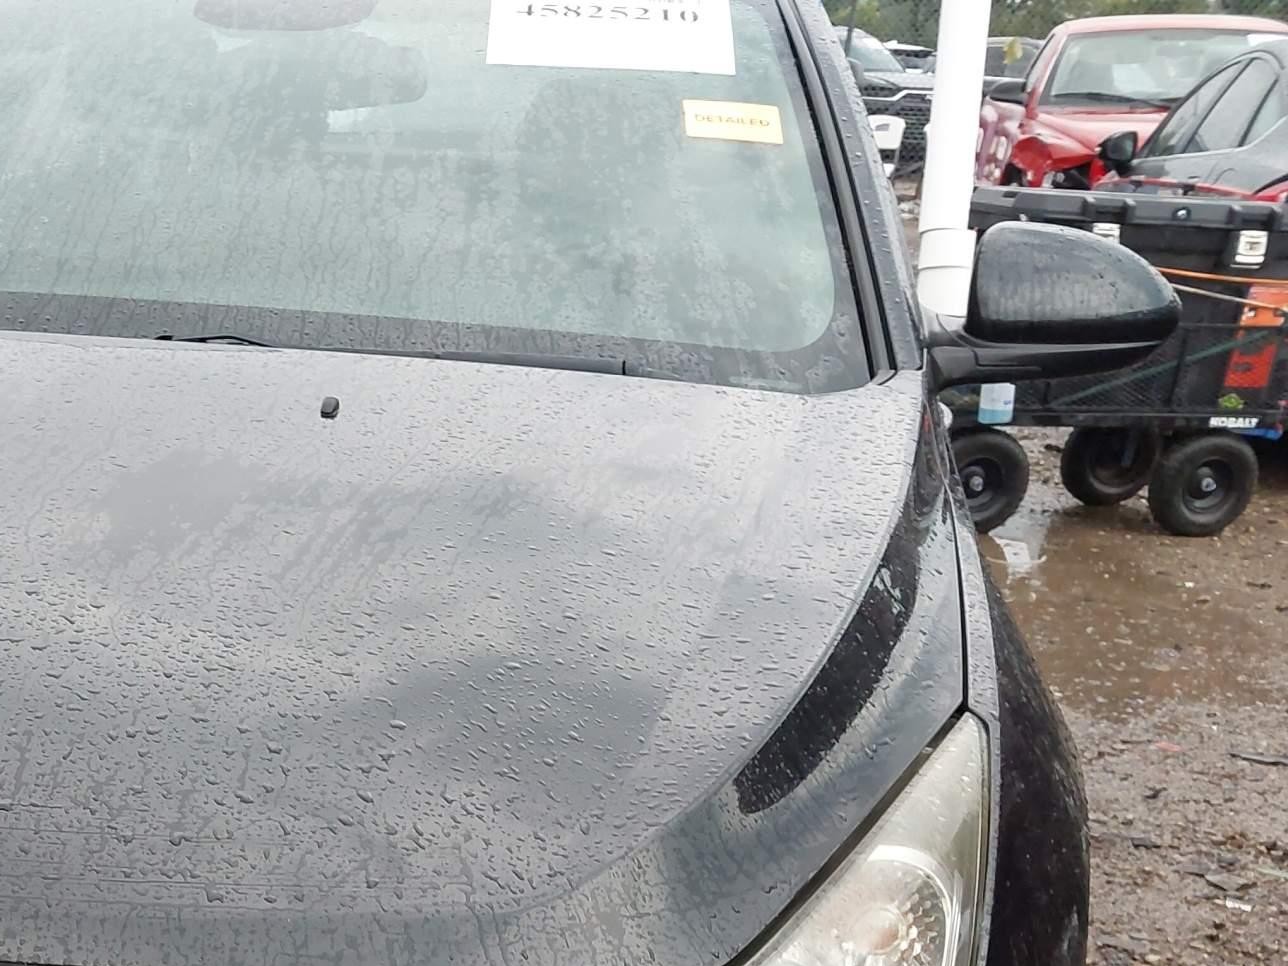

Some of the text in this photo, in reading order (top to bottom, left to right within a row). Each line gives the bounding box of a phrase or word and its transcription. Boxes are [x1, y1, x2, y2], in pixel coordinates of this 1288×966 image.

[516, 4, 699, 23] 45825210
[694, 113, 771, 127] DETAILED
[1209, 416, 1259, 428] KOBALT
